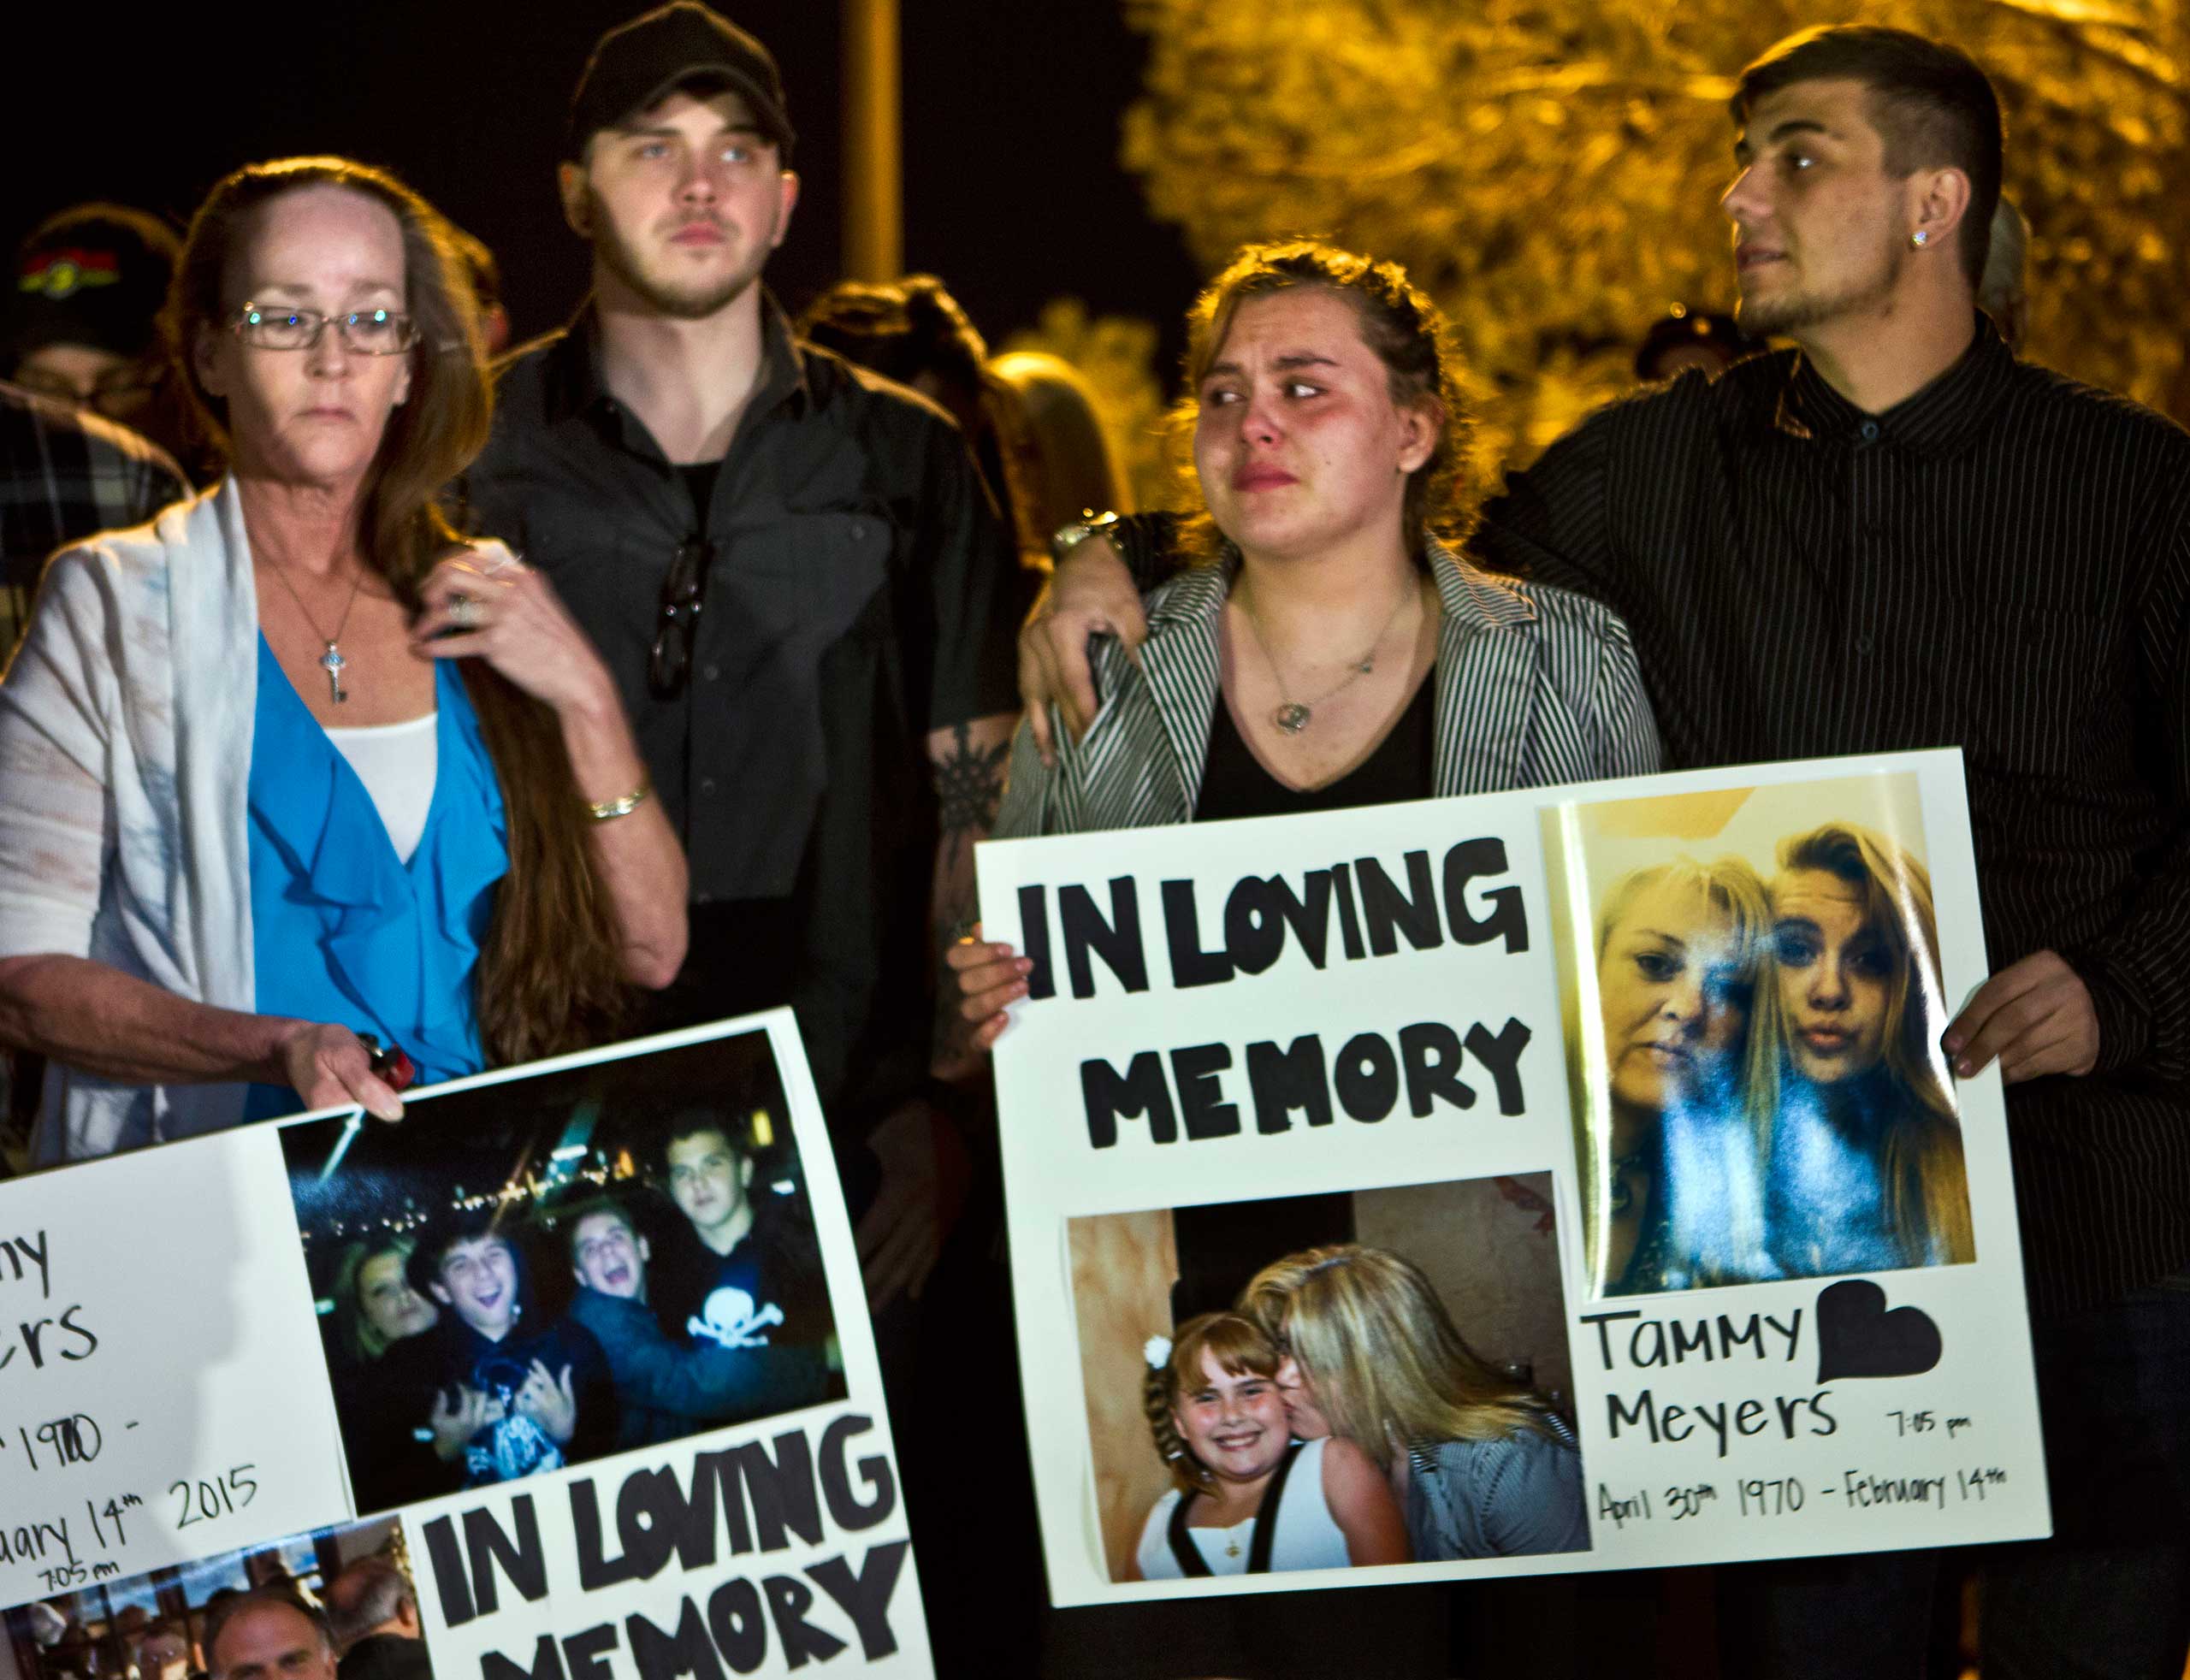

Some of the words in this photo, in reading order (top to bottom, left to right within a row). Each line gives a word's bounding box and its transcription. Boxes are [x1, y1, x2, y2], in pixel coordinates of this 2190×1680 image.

[1018, 875, 1150, 1001] IN
[1161, 837, 1530, 988] LOVING
[1080, 1017, 1532, 1150] MEMORY
[1606, 1389, 1838, 1458] Meyers
[1885, 1410, 1936, 1437] 7:05
[1945, 1417, 1972, 1440] pm
[169, 1464, 257, 1529] 2015
[423, 1494, 548, 1628] IN
[568, 1415, 897, 1592] LOVING
[1598, 1482, 1652, 1529] April
[1737, 1476, 1805, 1517] 1970
[1844, 1469, 1946, 1510] February
[480, 1540, 911, 1680] MEMORY
